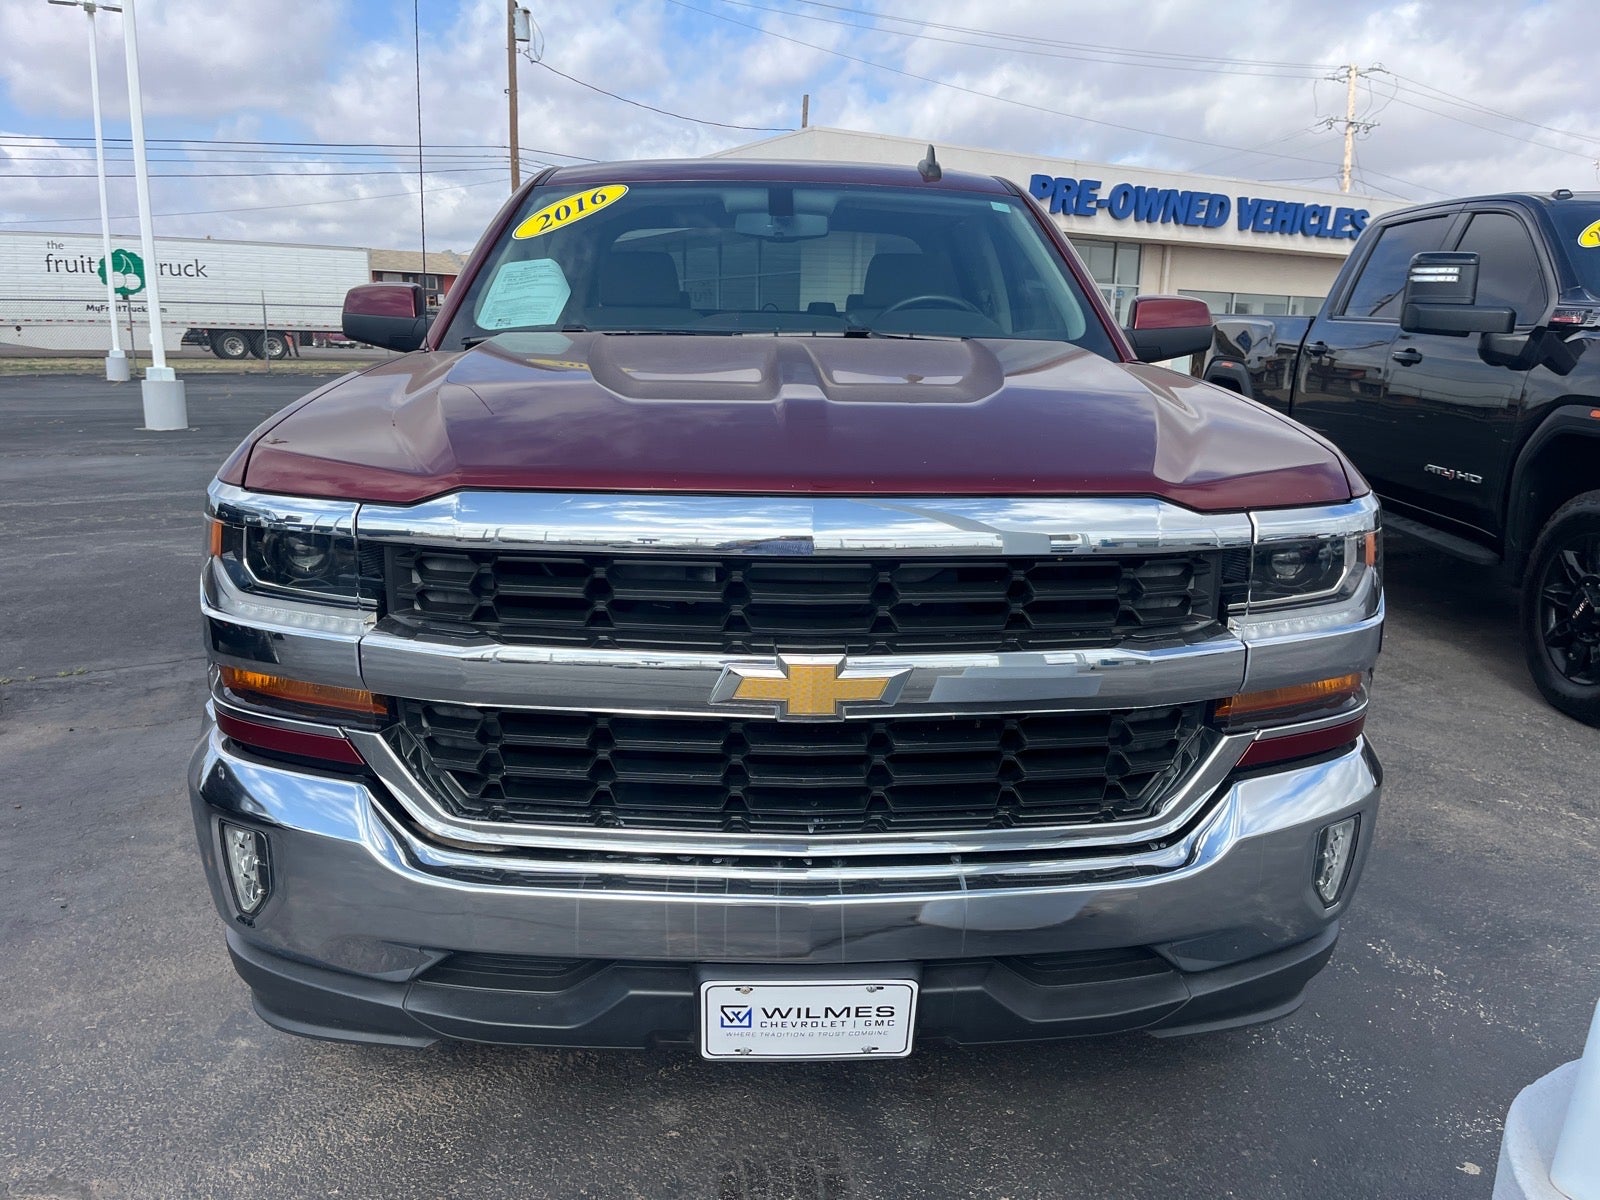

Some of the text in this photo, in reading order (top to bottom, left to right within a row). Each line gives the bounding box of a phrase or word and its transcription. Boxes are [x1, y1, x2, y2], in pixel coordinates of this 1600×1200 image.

[535, 189, 607, 232] 2016
[1028, 173, 1370, 241] PRE-OWNED VEHICLES
[46, 240, 65, 250] the
[44, 253, 208, 278] fruit ruck
[761, 1005, 895, 1019] WILMES
[760, 1020, 846, 1028] CHEVROLET
[864, 1019, 895, 1027] GMC
